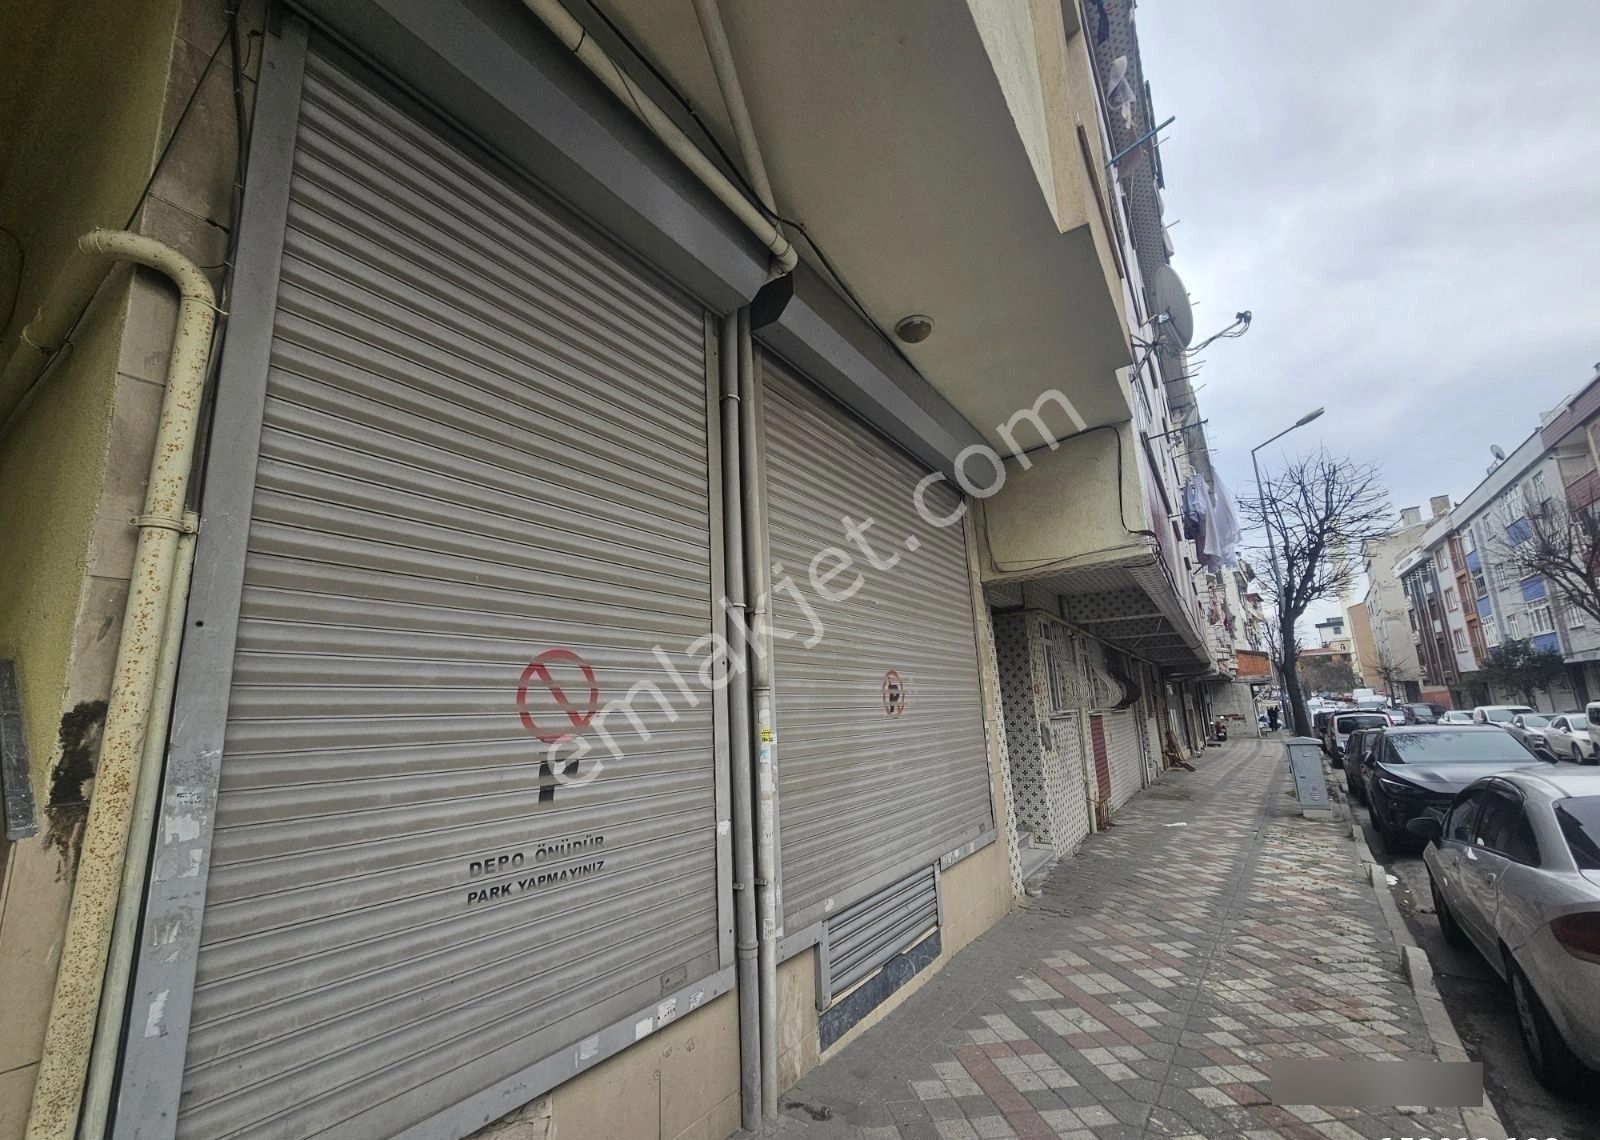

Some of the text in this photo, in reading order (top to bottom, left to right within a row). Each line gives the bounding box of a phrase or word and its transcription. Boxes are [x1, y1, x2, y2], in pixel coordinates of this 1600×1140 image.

[469, 834, 605, 878] DEPO ÖNÜDÜR
[467, 860, 605, 905] PARK YAPMAYINIZ
